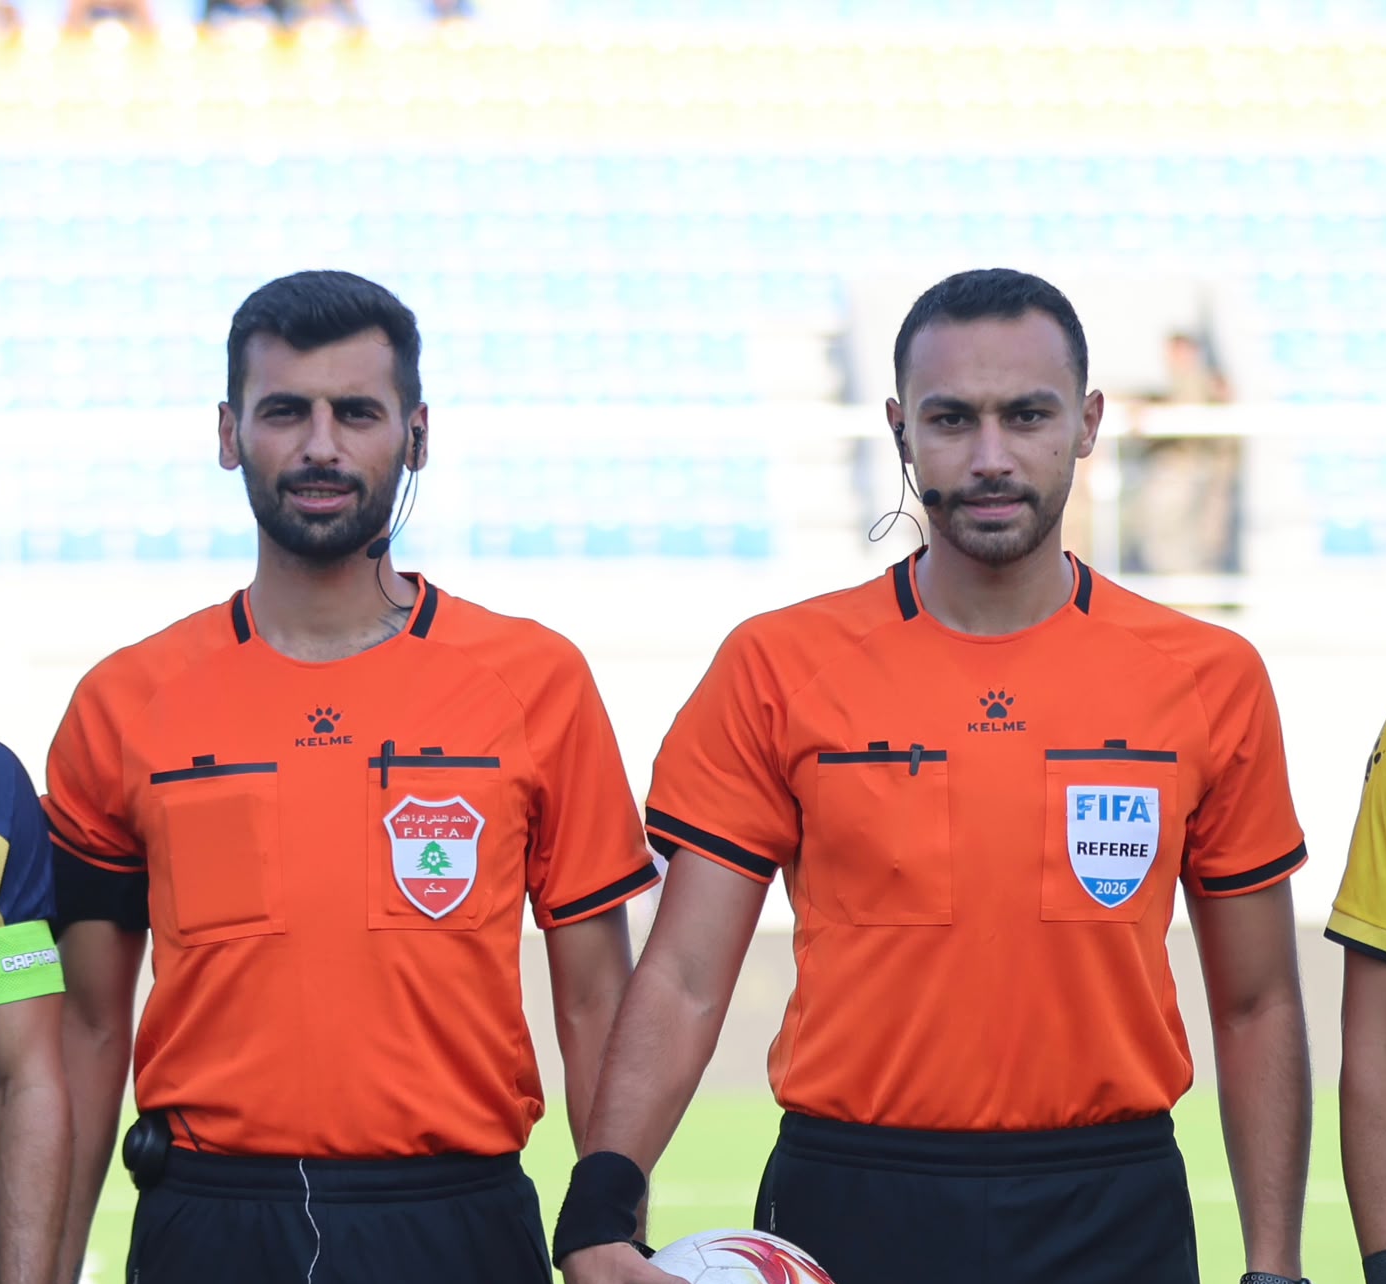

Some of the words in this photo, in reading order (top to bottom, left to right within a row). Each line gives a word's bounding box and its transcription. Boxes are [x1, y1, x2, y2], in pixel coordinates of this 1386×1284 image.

[967, 721, 1027, 733] KELME
[295, 735, 353, 748] KELME
[1076, 793, 1151, 823] FIFA
[404, 828, 464, 838] F.L.F.A.
[1076, 841, 1149, 857] REFEREE
[1095, 881, 1128, 895] 2026
